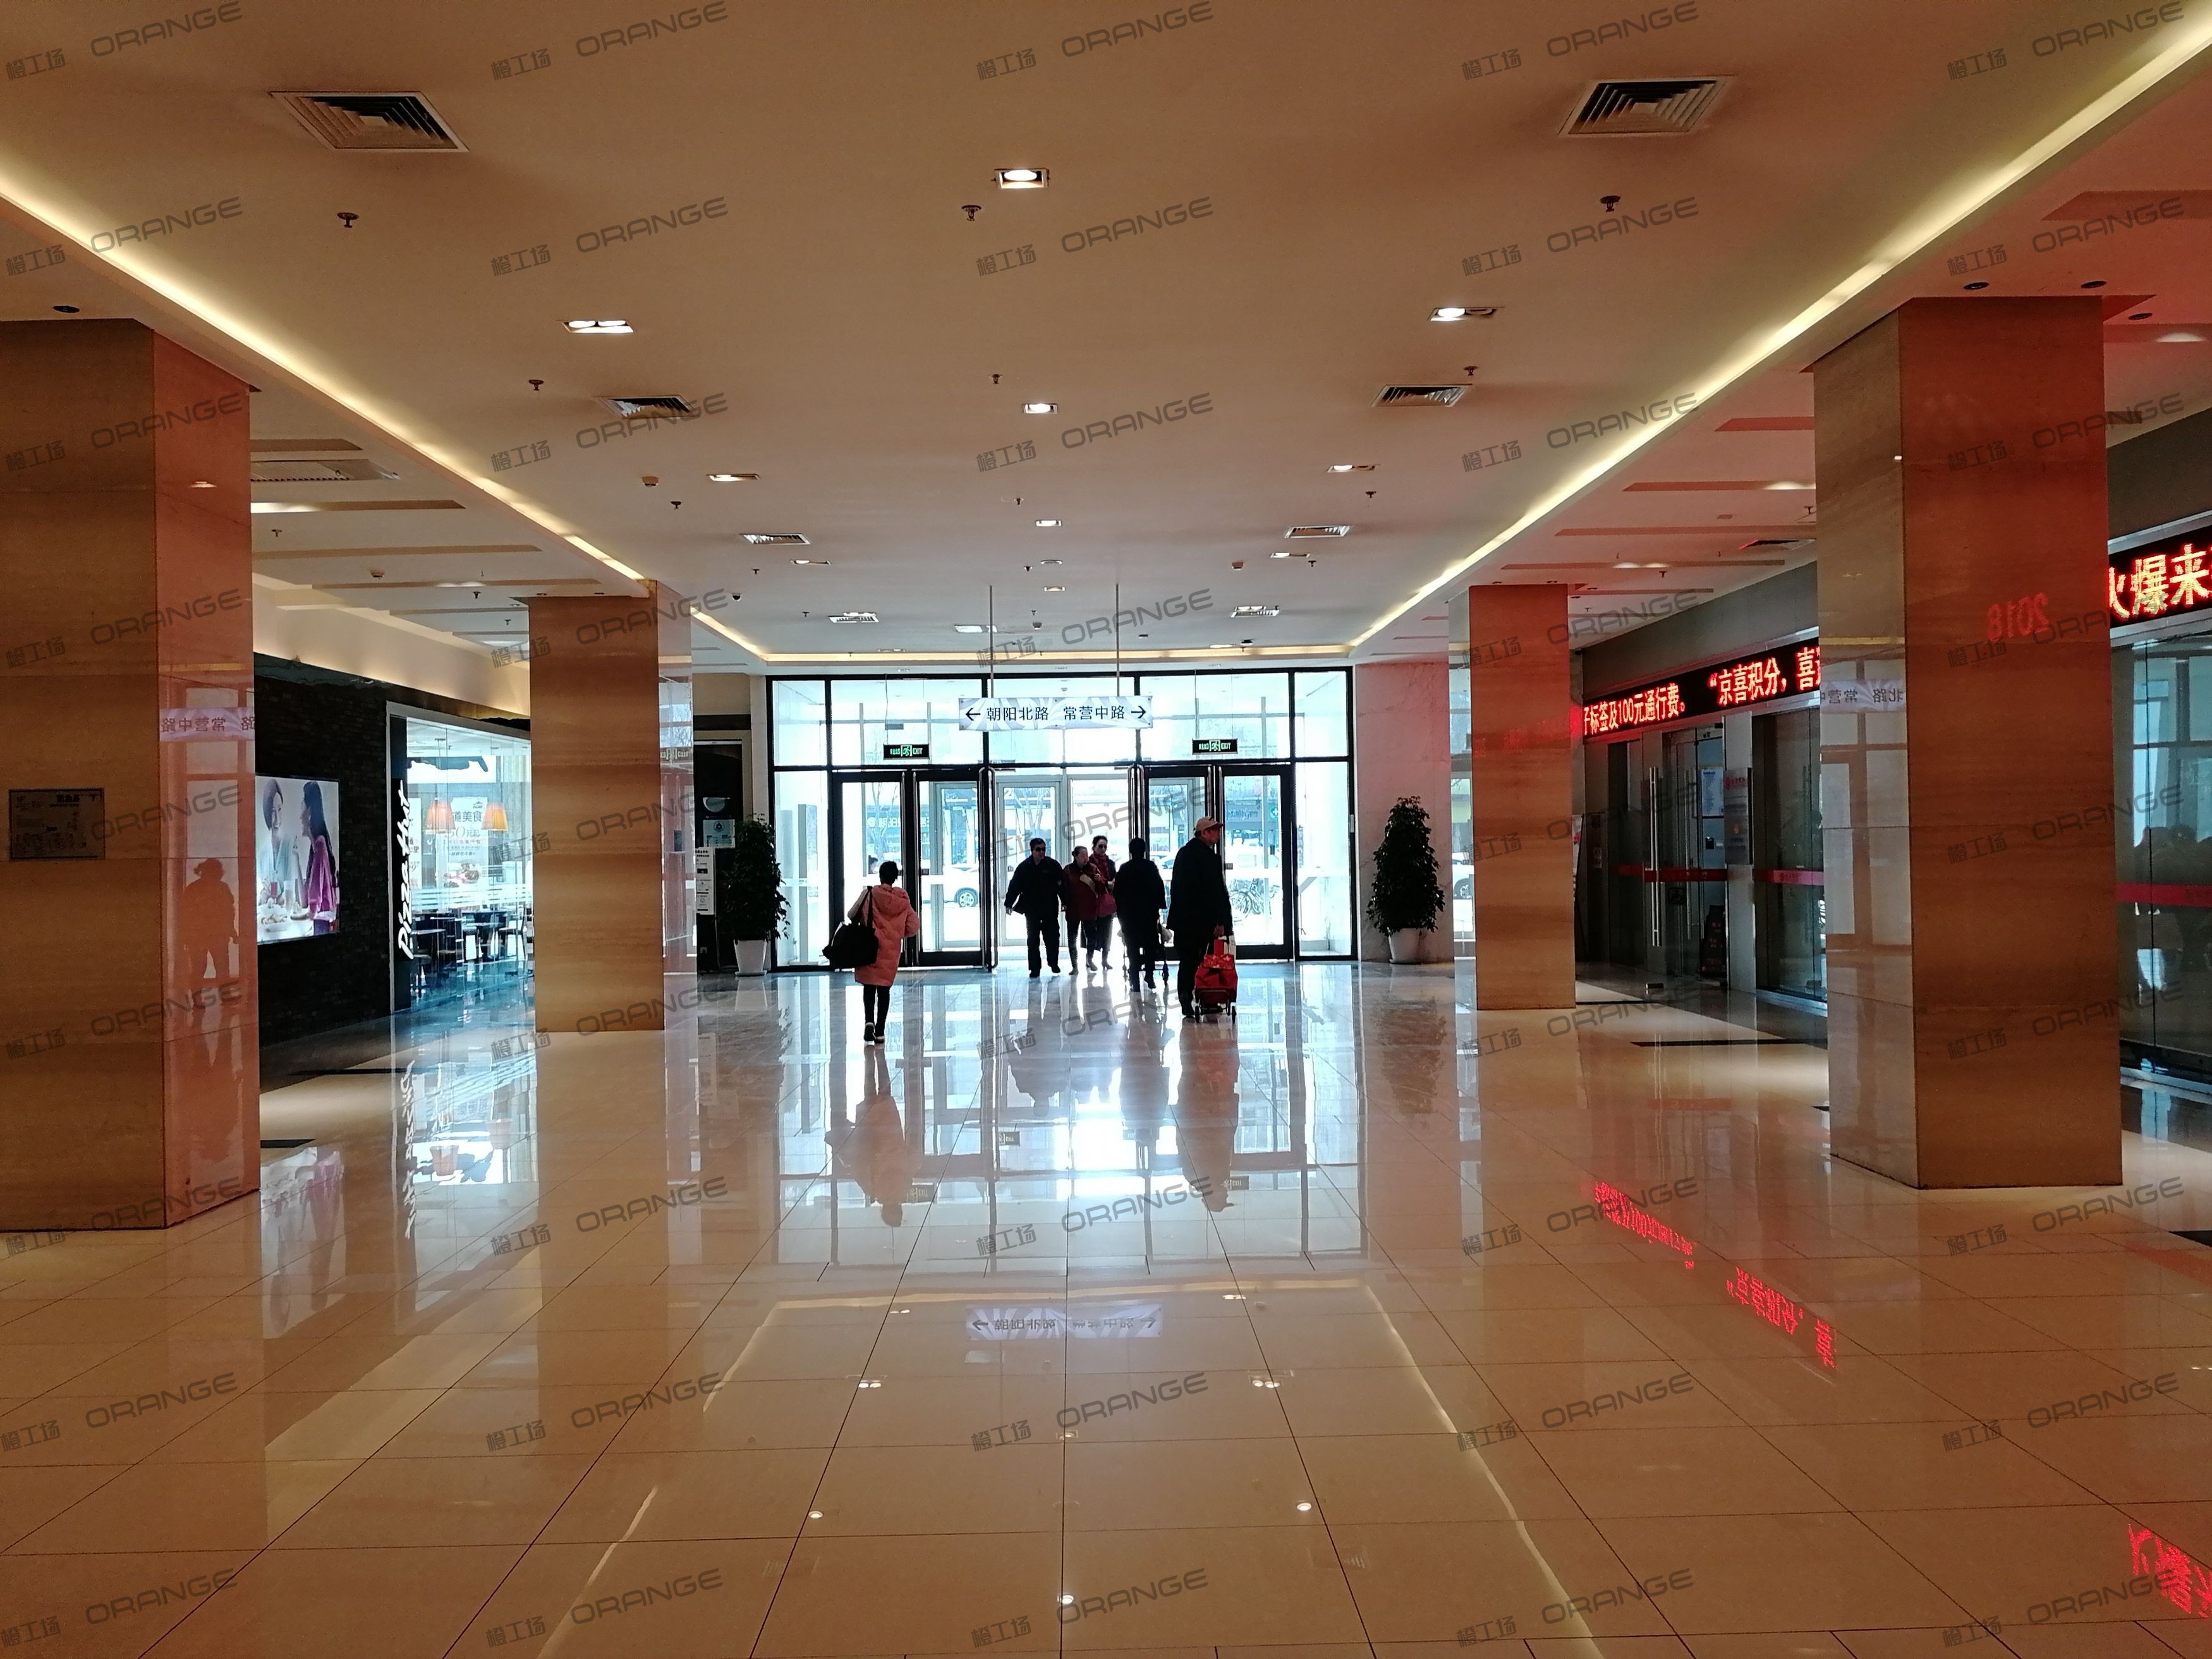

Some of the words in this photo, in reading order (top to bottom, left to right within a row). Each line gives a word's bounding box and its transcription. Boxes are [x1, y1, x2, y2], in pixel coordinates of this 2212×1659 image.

[987, 707, 1049, 721] 朝阳北路
[1063, 705, 1125, 720] 常营中路
[398, 860, 414, 960] Pizza
